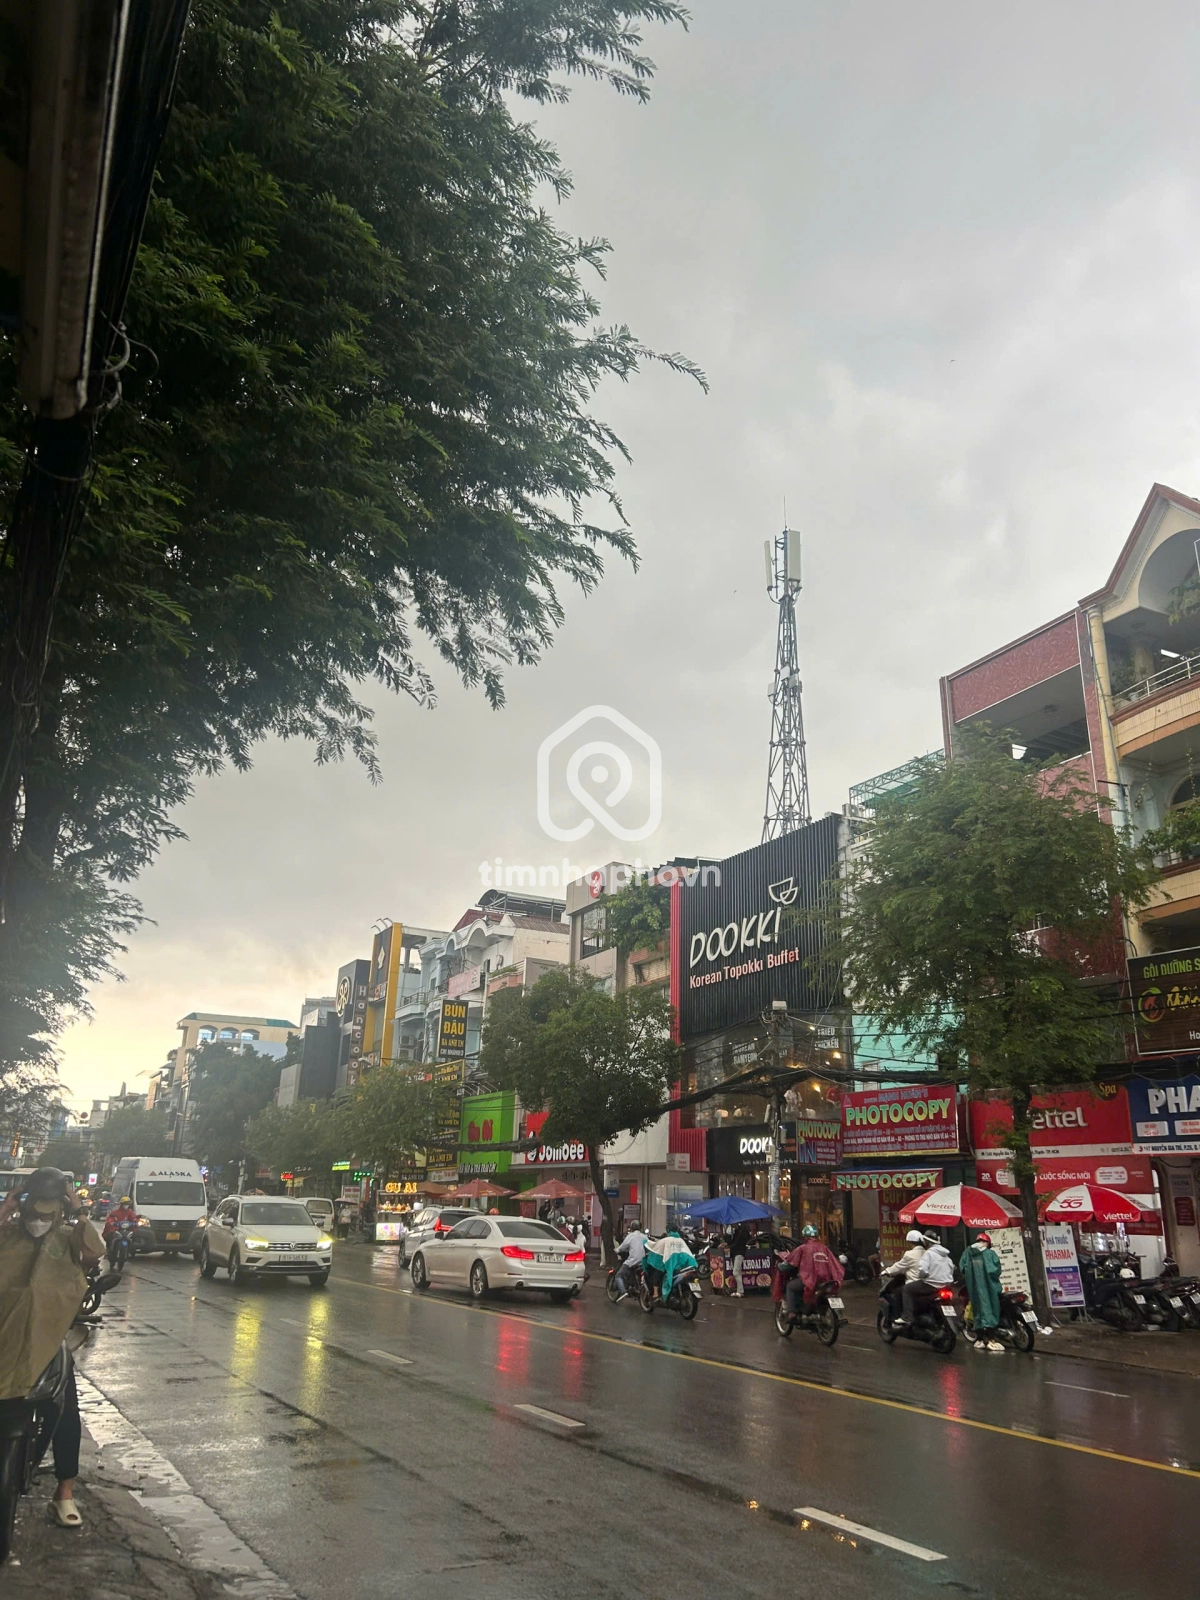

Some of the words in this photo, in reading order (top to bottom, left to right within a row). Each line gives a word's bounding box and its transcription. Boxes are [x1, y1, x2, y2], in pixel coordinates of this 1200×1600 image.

[690, 906, 782, 969] DOOKKI
[690, 970, 722, 989] Korean
[723, 958, 764, 980] Topokki
[767, 946, 800, 969] Buffet
[1143, 963, 1159, 981] GỘI
[1161, 959, 1193, 975] DƯỠNG
[444, 1002, 466, 1018] BÚN
[443, 1019, 465, 1037] ĐẬU
[1098, 1082, 1118, 1097] Spa
[845, 1098, 951, 1126] PHOTOCOPY
[1026, 1106, 1088, 1130] ettel
[798, 1120, 842, 1139] PHOTOCOPY
[739, 1136, 773, 1155] DOOK
[836, 1172, 939, 1189] PHOTOCOPY
[1040, 1172, 1058, 1180] CUỘC
[1058, 1170, 1076, 1180] SỐNG
[1076, 1171, 1091, 1179] MỚI
[1059, 1199, 1083, 1209] 5G
[969, 1218, 1001, 1227] viettel
[1103, 1212, 1134, 1220] viettel
[743, 1259, 761, 1270] KHOAI
